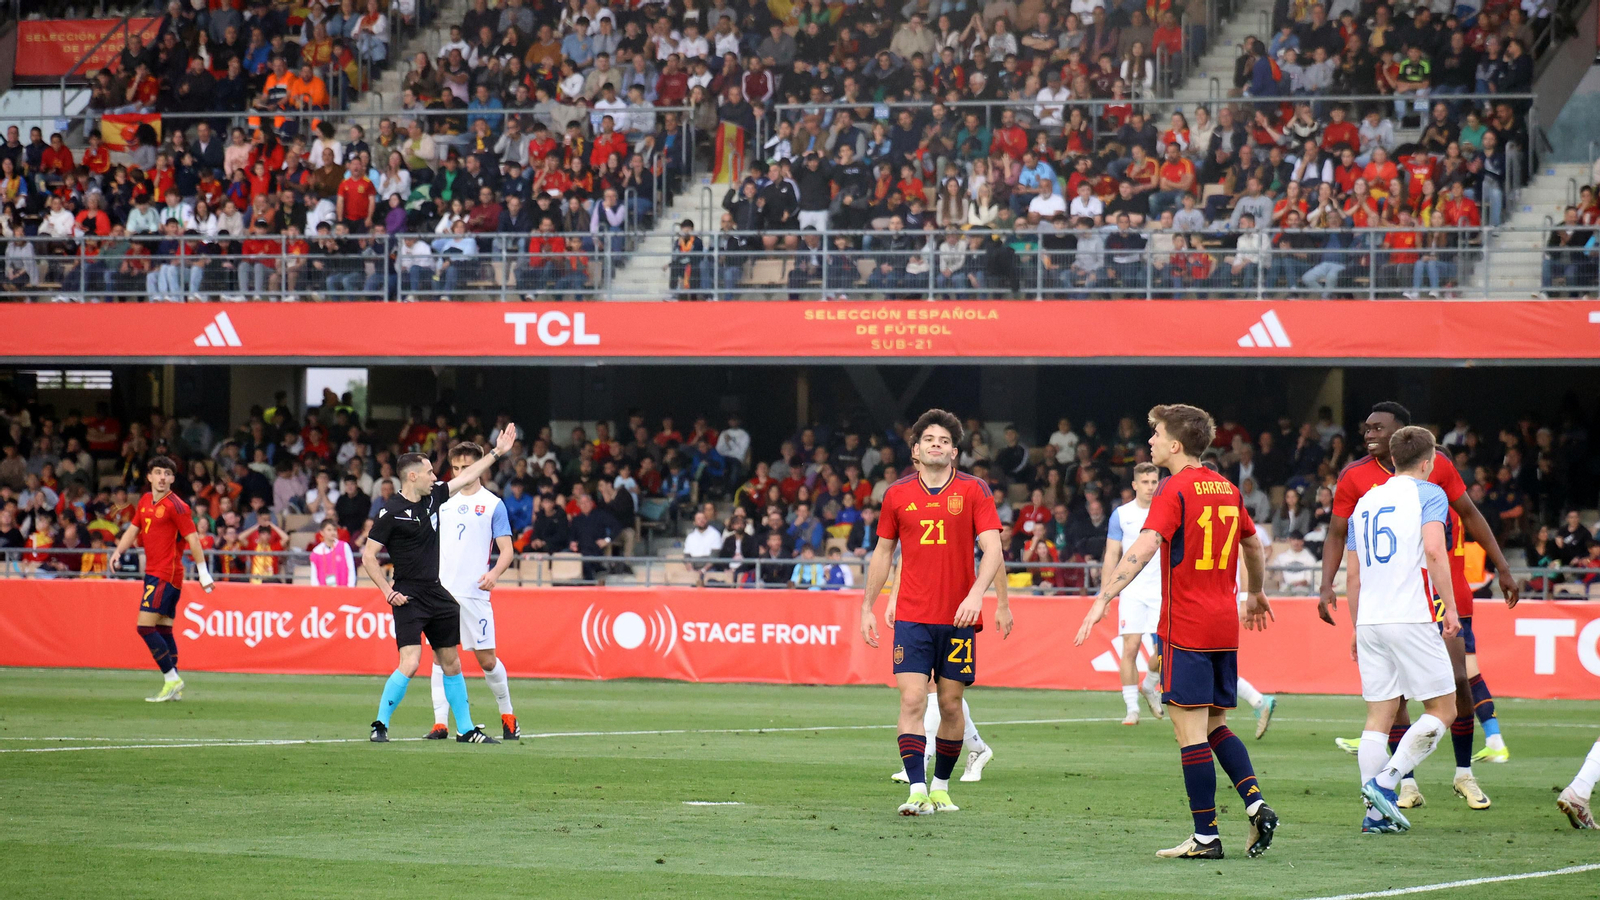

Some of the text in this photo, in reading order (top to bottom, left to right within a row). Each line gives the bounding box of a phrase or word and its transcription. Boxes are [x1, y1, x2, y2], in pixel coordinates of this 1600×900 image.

[804, 306, 999, 320] SELECCIÓN ESPAÑOLA
[504, 310, 600, 346] TCL
[856, 322, 952, 335] DE FÚTBOL
[871, 339, 933, 350] SUB-21
[145, 518, 152, 534] 7
[920, 519, 947, 545] 21
[1195, 505, 1239, 570] 17
[1362, 506, 1397, 567] 16
[144, 584, 155, 601] 7
[182, 602, 295, 648] Sangre
[300, 606, 338, 639] de
[682, 622, 841, 645] STAGE FRONT
[948, 638, 973, 663] 21
